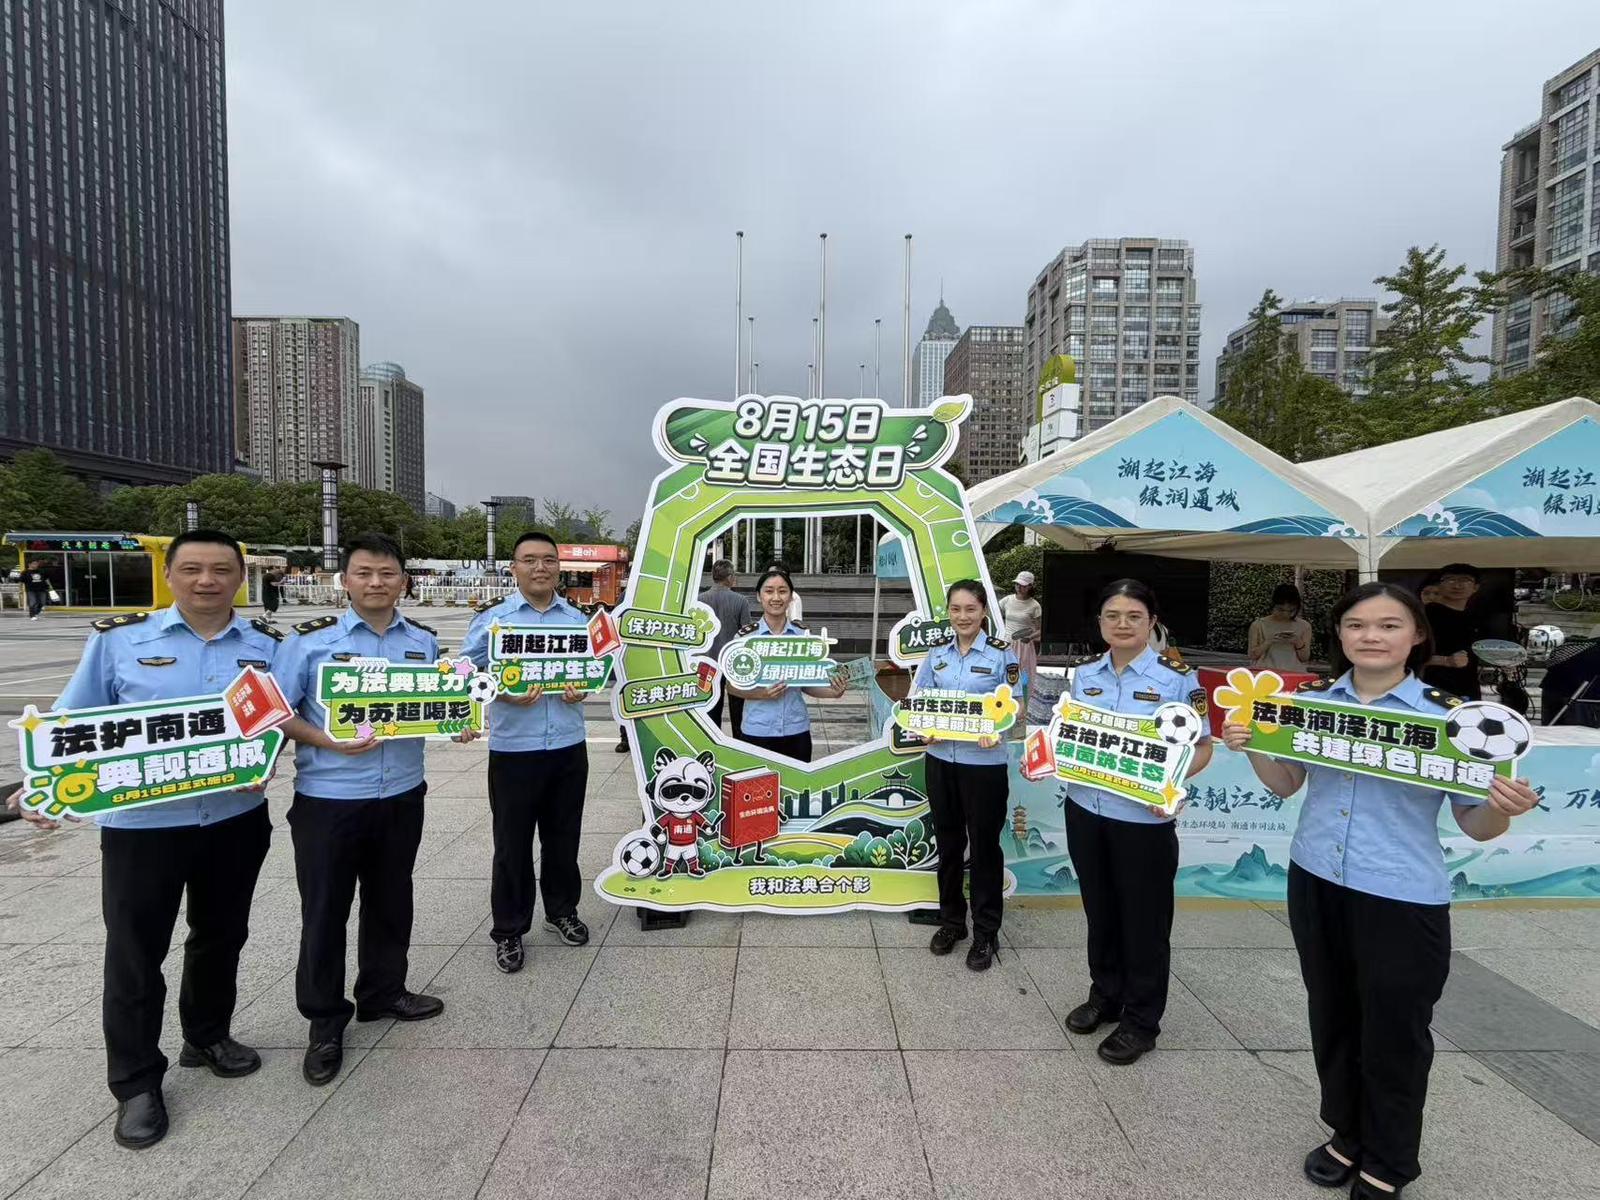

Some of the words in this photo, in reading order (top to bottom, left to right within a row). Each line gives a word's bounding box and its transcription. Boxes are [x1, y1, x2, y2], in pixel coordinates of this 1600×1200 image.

[734, 399, 883, 442] 8月15日
[705, 438, 904, 486] 全国生态日
[1118, 457, 1218, 483] 潮起江海
[1522, 466, 1597, 489] 潮起江
[1140, 484, 1240, 512] 绿润通城
[1543, 493, 1600, 516] 绿润
[627, 616, 697, 640] 保护环境
[501, 634, 588, 654] 潮起江海
[752, 640, 823, 657] 潮起江海
[330, 672, 465, 693] 为法典聚力
[521, 660, 605, 682] 法护生态
[631, 682, 698, 705] 法典护航
[338, 701, 472, 725] 为苏超喝彩
[1252, 700, 1438, 750] 法典润泽江海
[51, 708, 226, 757] 法护南通
[1057, 722, 1168, 763] 法治护江海
[96, 739, 266, 793] 典靓通城
[1055, 739, 1166, 783] 绿茵筑生态
[1292, 731, 1496, 790] 共建绿色南通
[111, 773, 236, 803] 8月15日正式施行
[673, 824, 693, 835] 南通
[749, 876, 870, 895] 我和法典合个影
